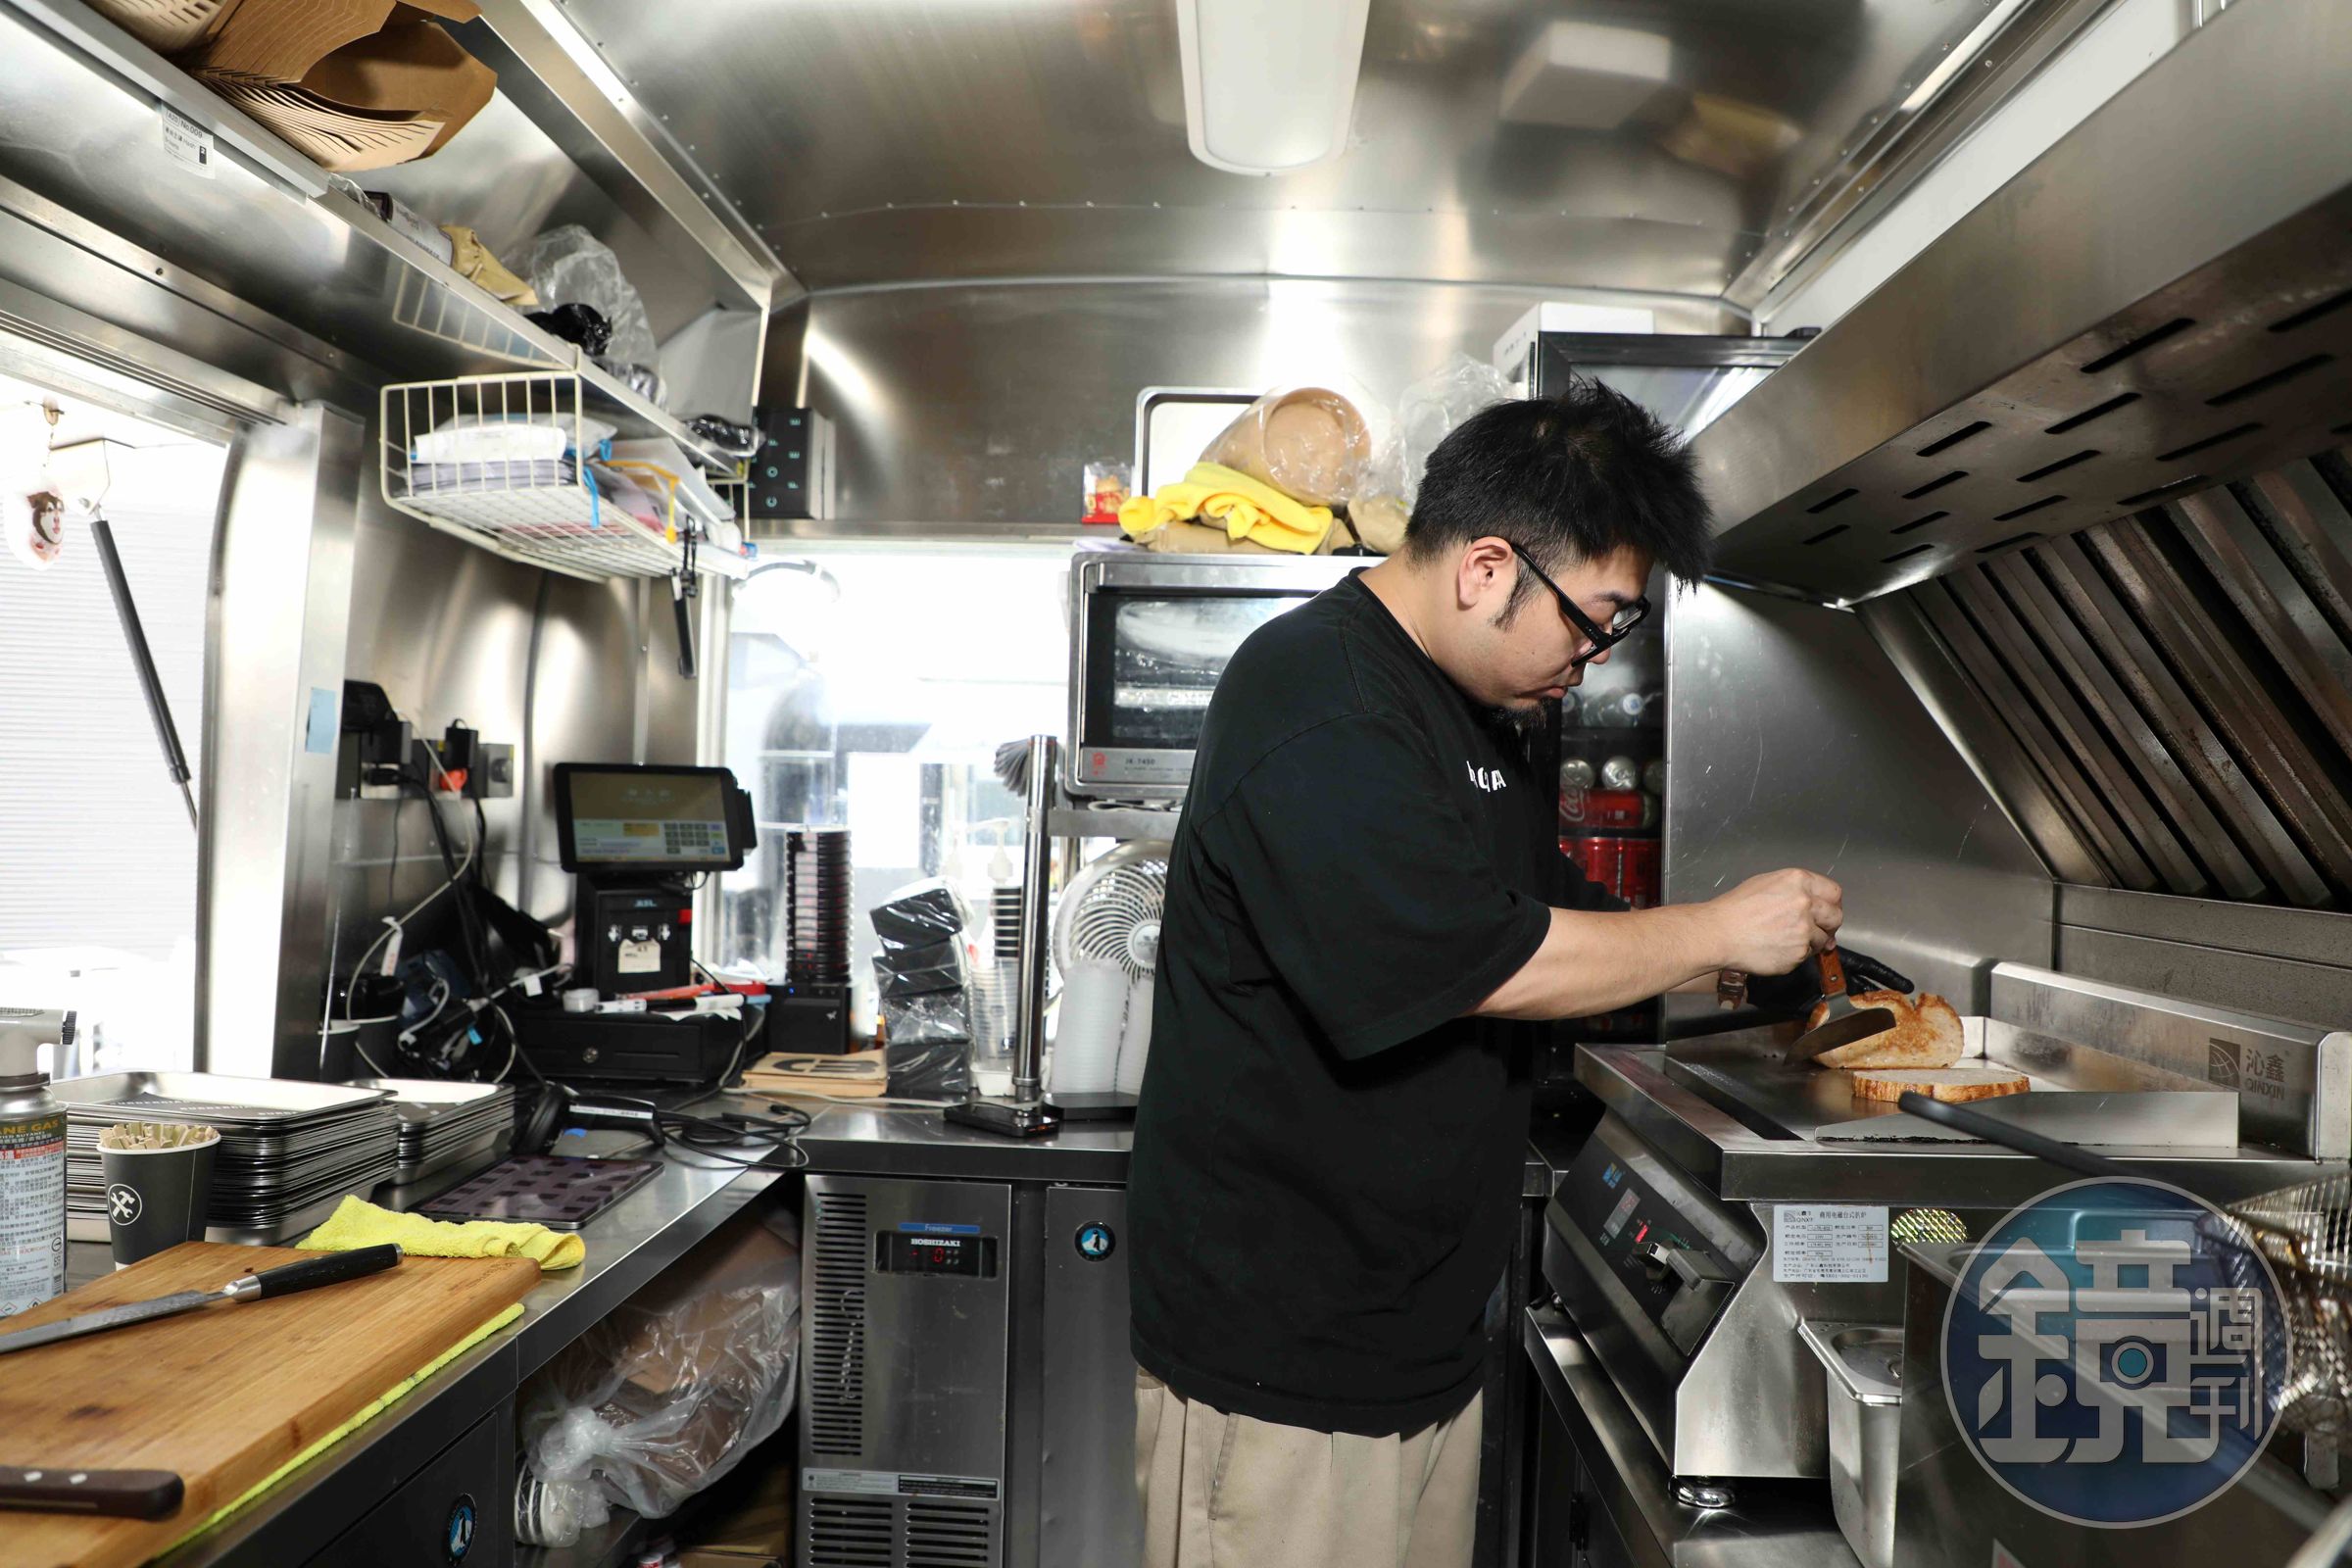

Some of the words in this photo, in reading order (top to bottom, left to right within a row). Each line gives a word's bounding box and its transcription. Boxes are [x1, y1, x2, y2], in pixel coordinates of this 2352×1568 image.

[2245, 1048, 2284, 1083] 沁鑫
[2245, 1078, 2285, 1100] QINXIN
[910, 1238, 961, 1248] HOSHIZAKI
